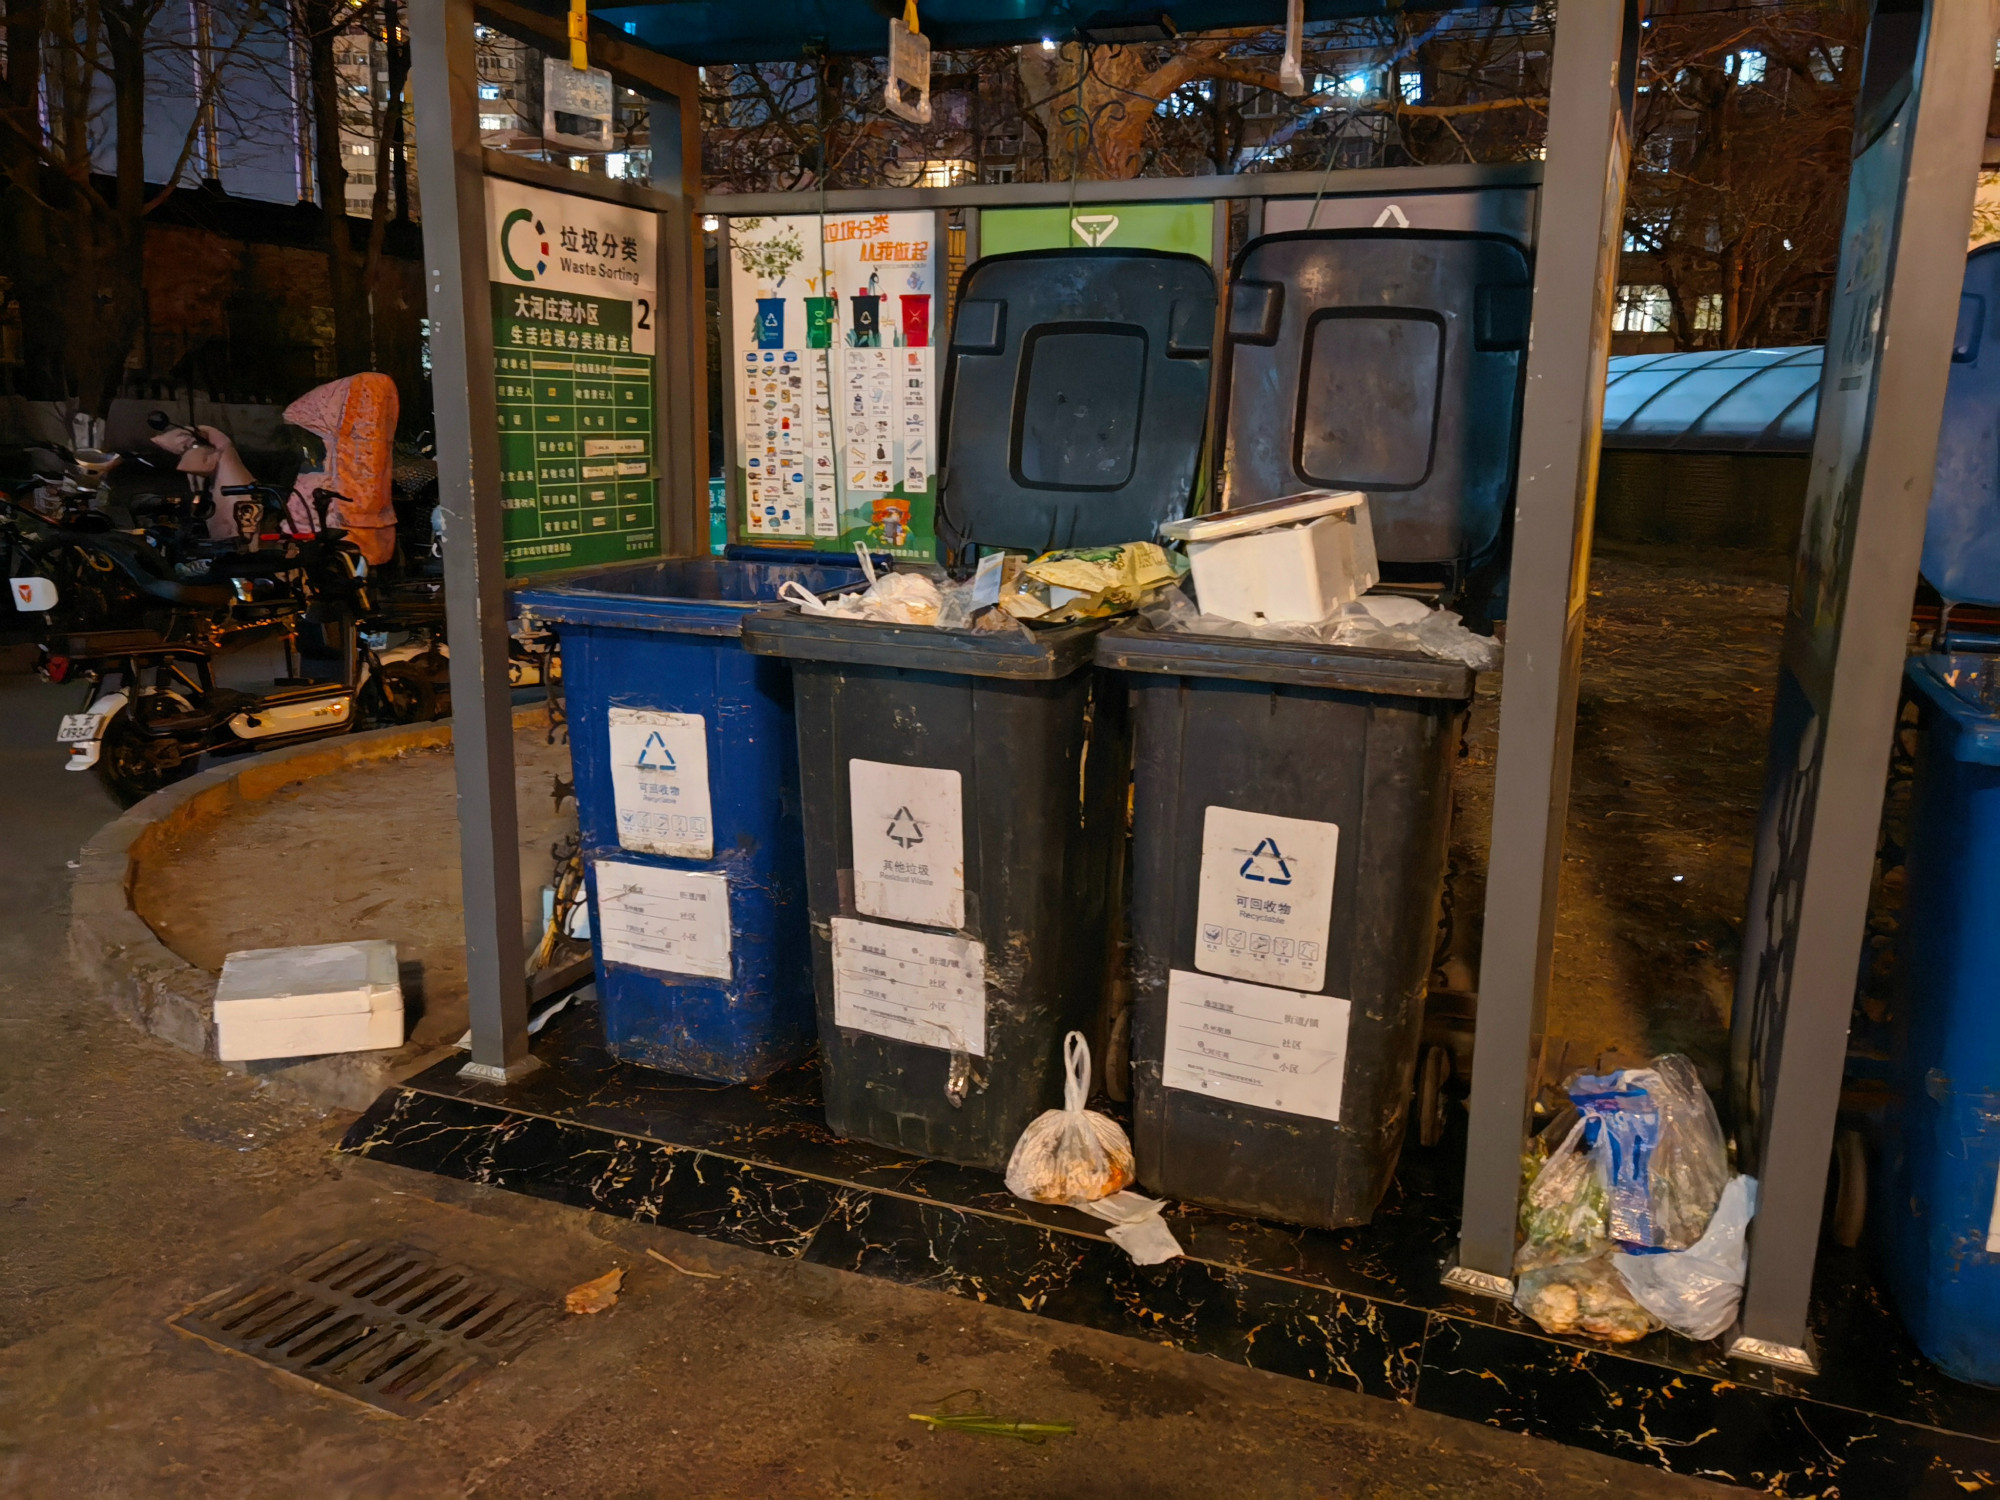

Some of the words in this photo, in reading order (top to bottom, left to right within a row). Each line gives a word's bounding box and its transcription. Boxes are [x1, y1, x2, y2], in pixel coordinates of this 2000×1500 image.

[560, 226, 638, 263] 垃圾分类
[560, 257, 596, 277] Waste
[599, 263, 639, 285] Sorting
[514, 293, 599, 326] 大河庄苑小区
[637, 299, 651, 330] 2
[511, 325, 630, 352] 生活垃圾分类投放点
[883, 860, 930, 876] 其他垃圾
[1236, 895, 1291, 915] 可回收物
[1239, 910, 1285, 924] Recyclable
[929, 1001, 946, 1011] 小区
[1282, 1038, 1302, 1050] 社区
[1279, 1063, 1299, 1074] 小区
